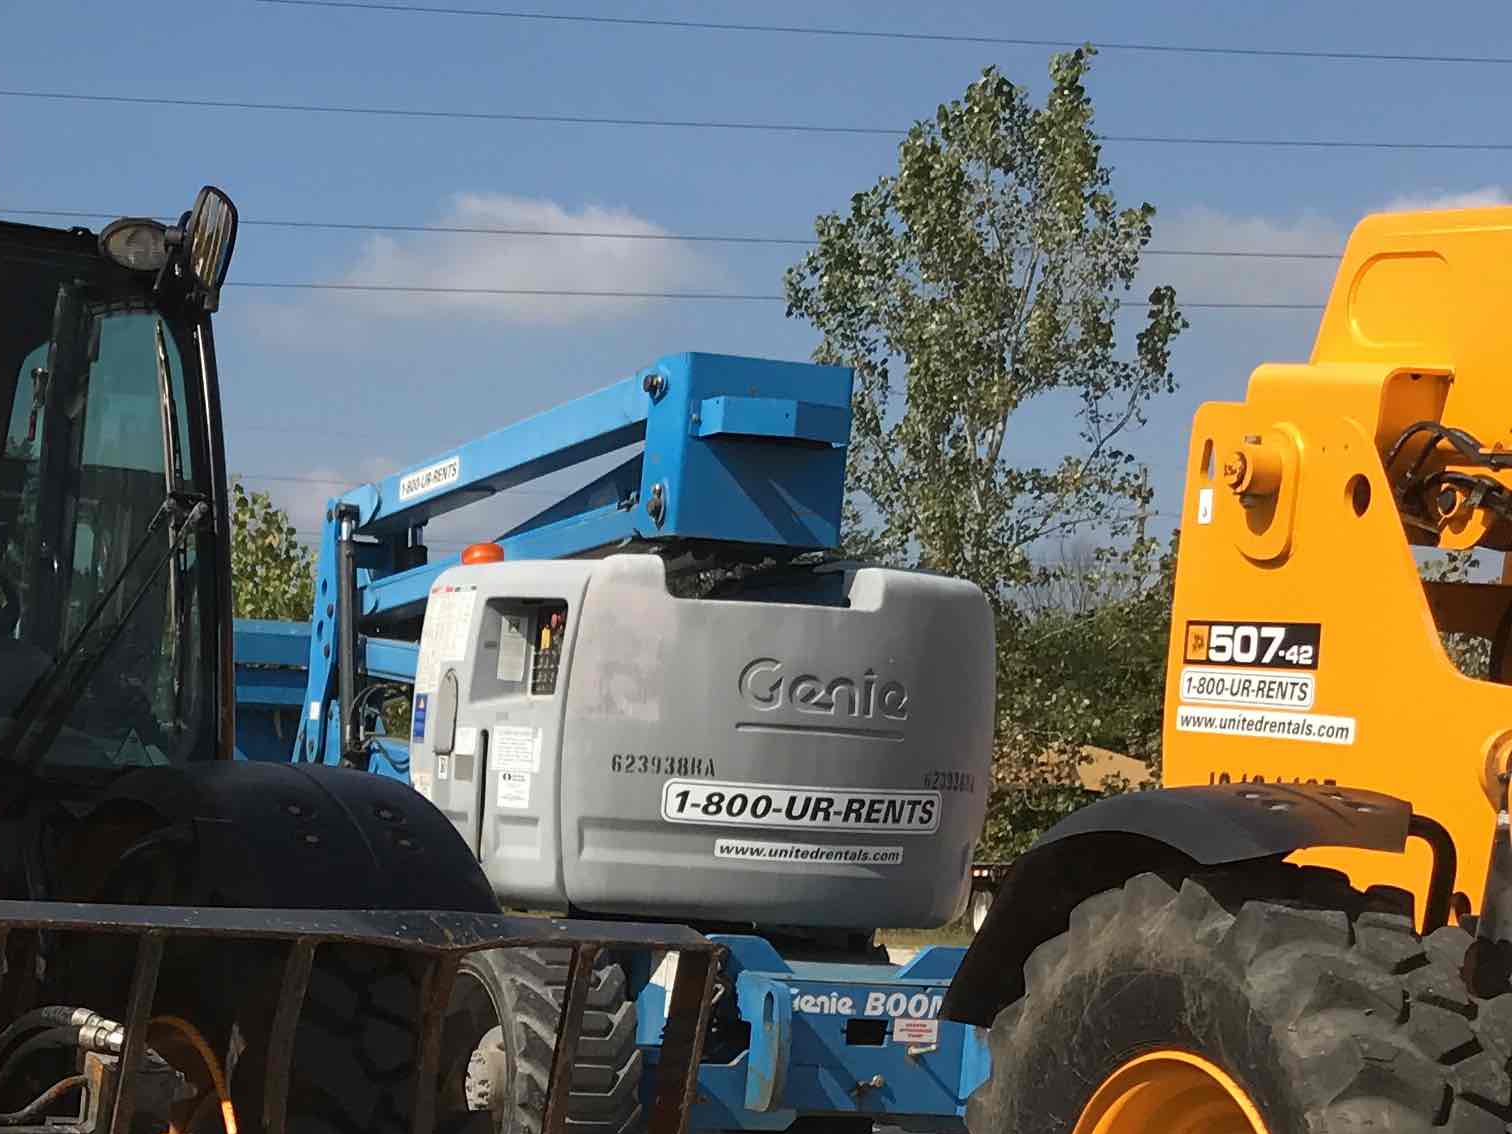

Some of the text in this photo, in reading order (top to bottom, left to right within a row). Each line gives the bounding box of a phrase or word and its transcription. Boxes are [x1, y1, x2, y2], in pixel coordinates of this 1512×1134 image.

[738, 657, 908, 720] Genie
[1186, 676, 1309, 702] 1-800-UR-RENTS
[1180, 713, 1350, 741] www.unitedrentals.com
[675, 789, 936, 826] 1-800-UR-RENTS
[719, 843, 900, 863] www.unitedrentals.com
